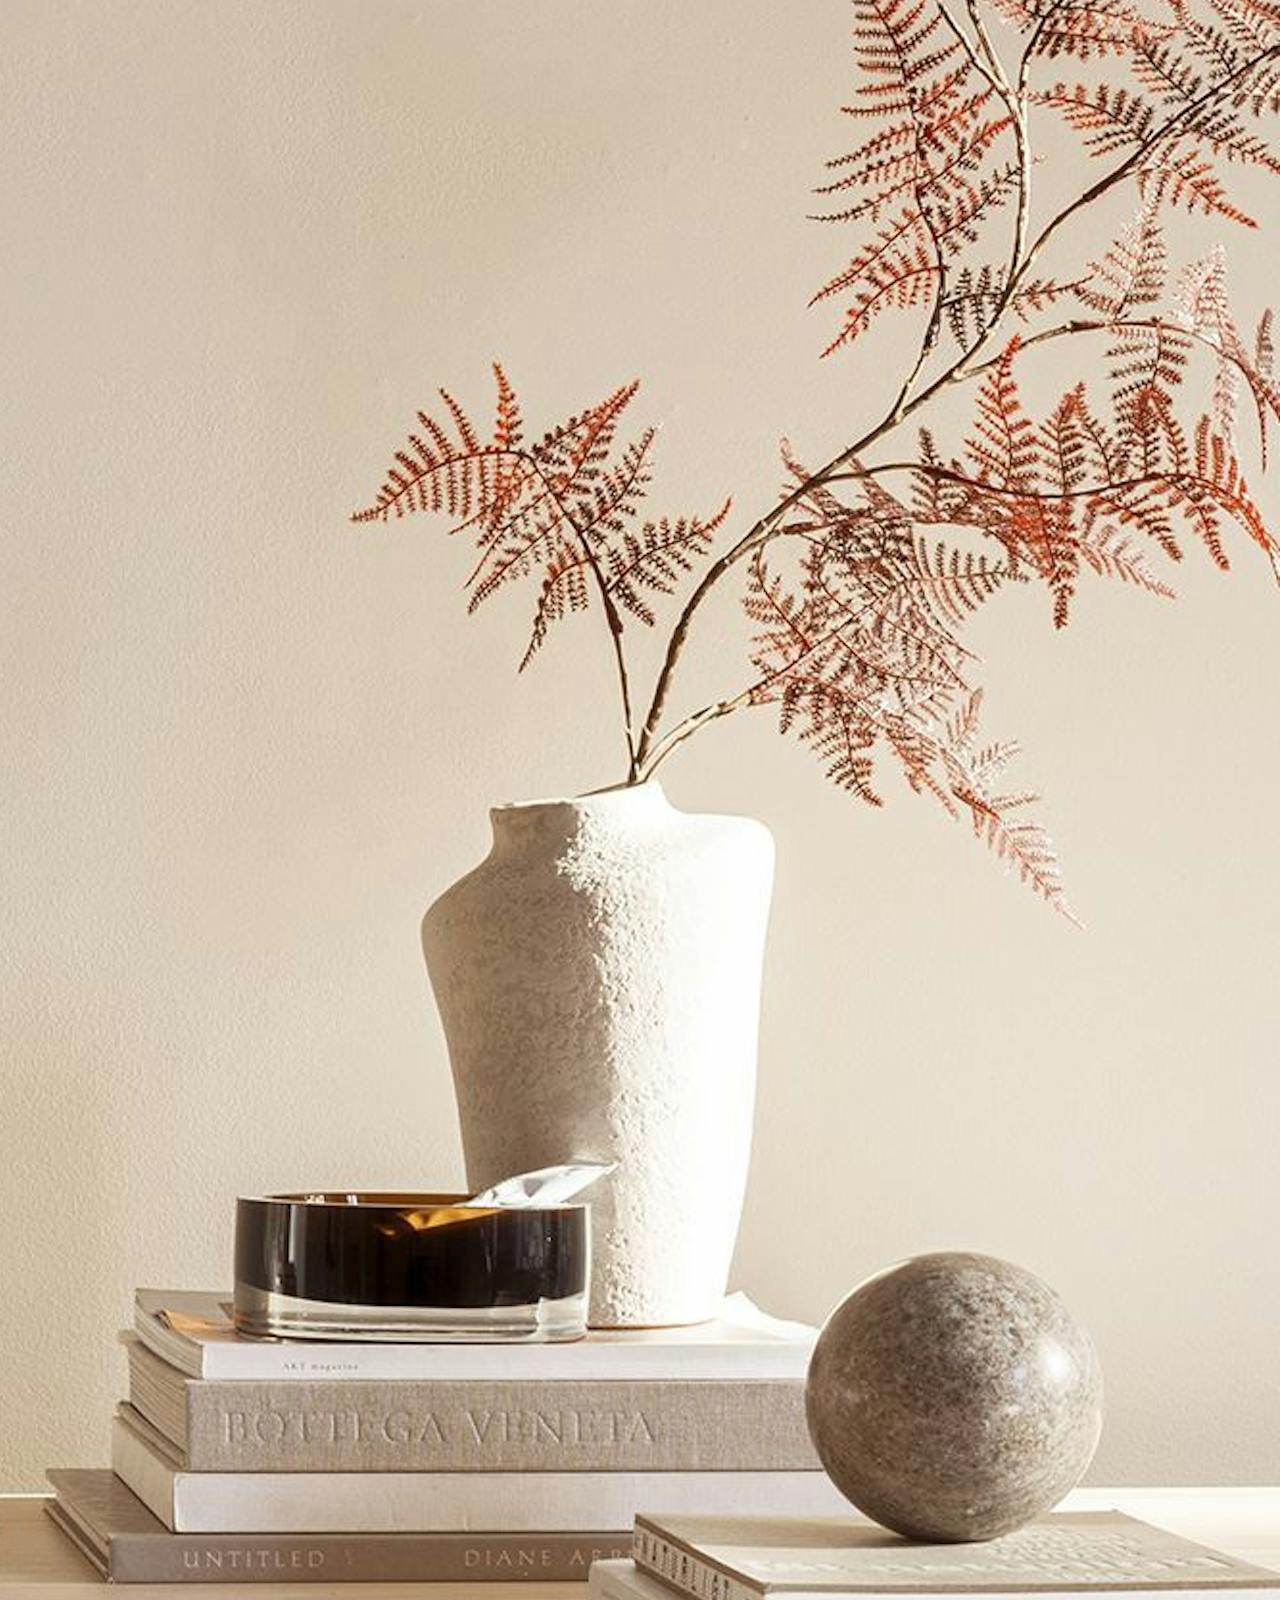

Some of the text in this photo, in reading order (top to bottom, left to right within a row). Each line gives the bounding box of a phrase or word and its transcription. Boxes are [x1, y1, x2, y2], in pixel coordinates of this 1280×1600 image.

[223, 1408, 658, 1446] BOTTEGA VENETA
[183, 1550, 326, 1569] UNTITLED
[464, 1549, 553, 1568] DIANE
